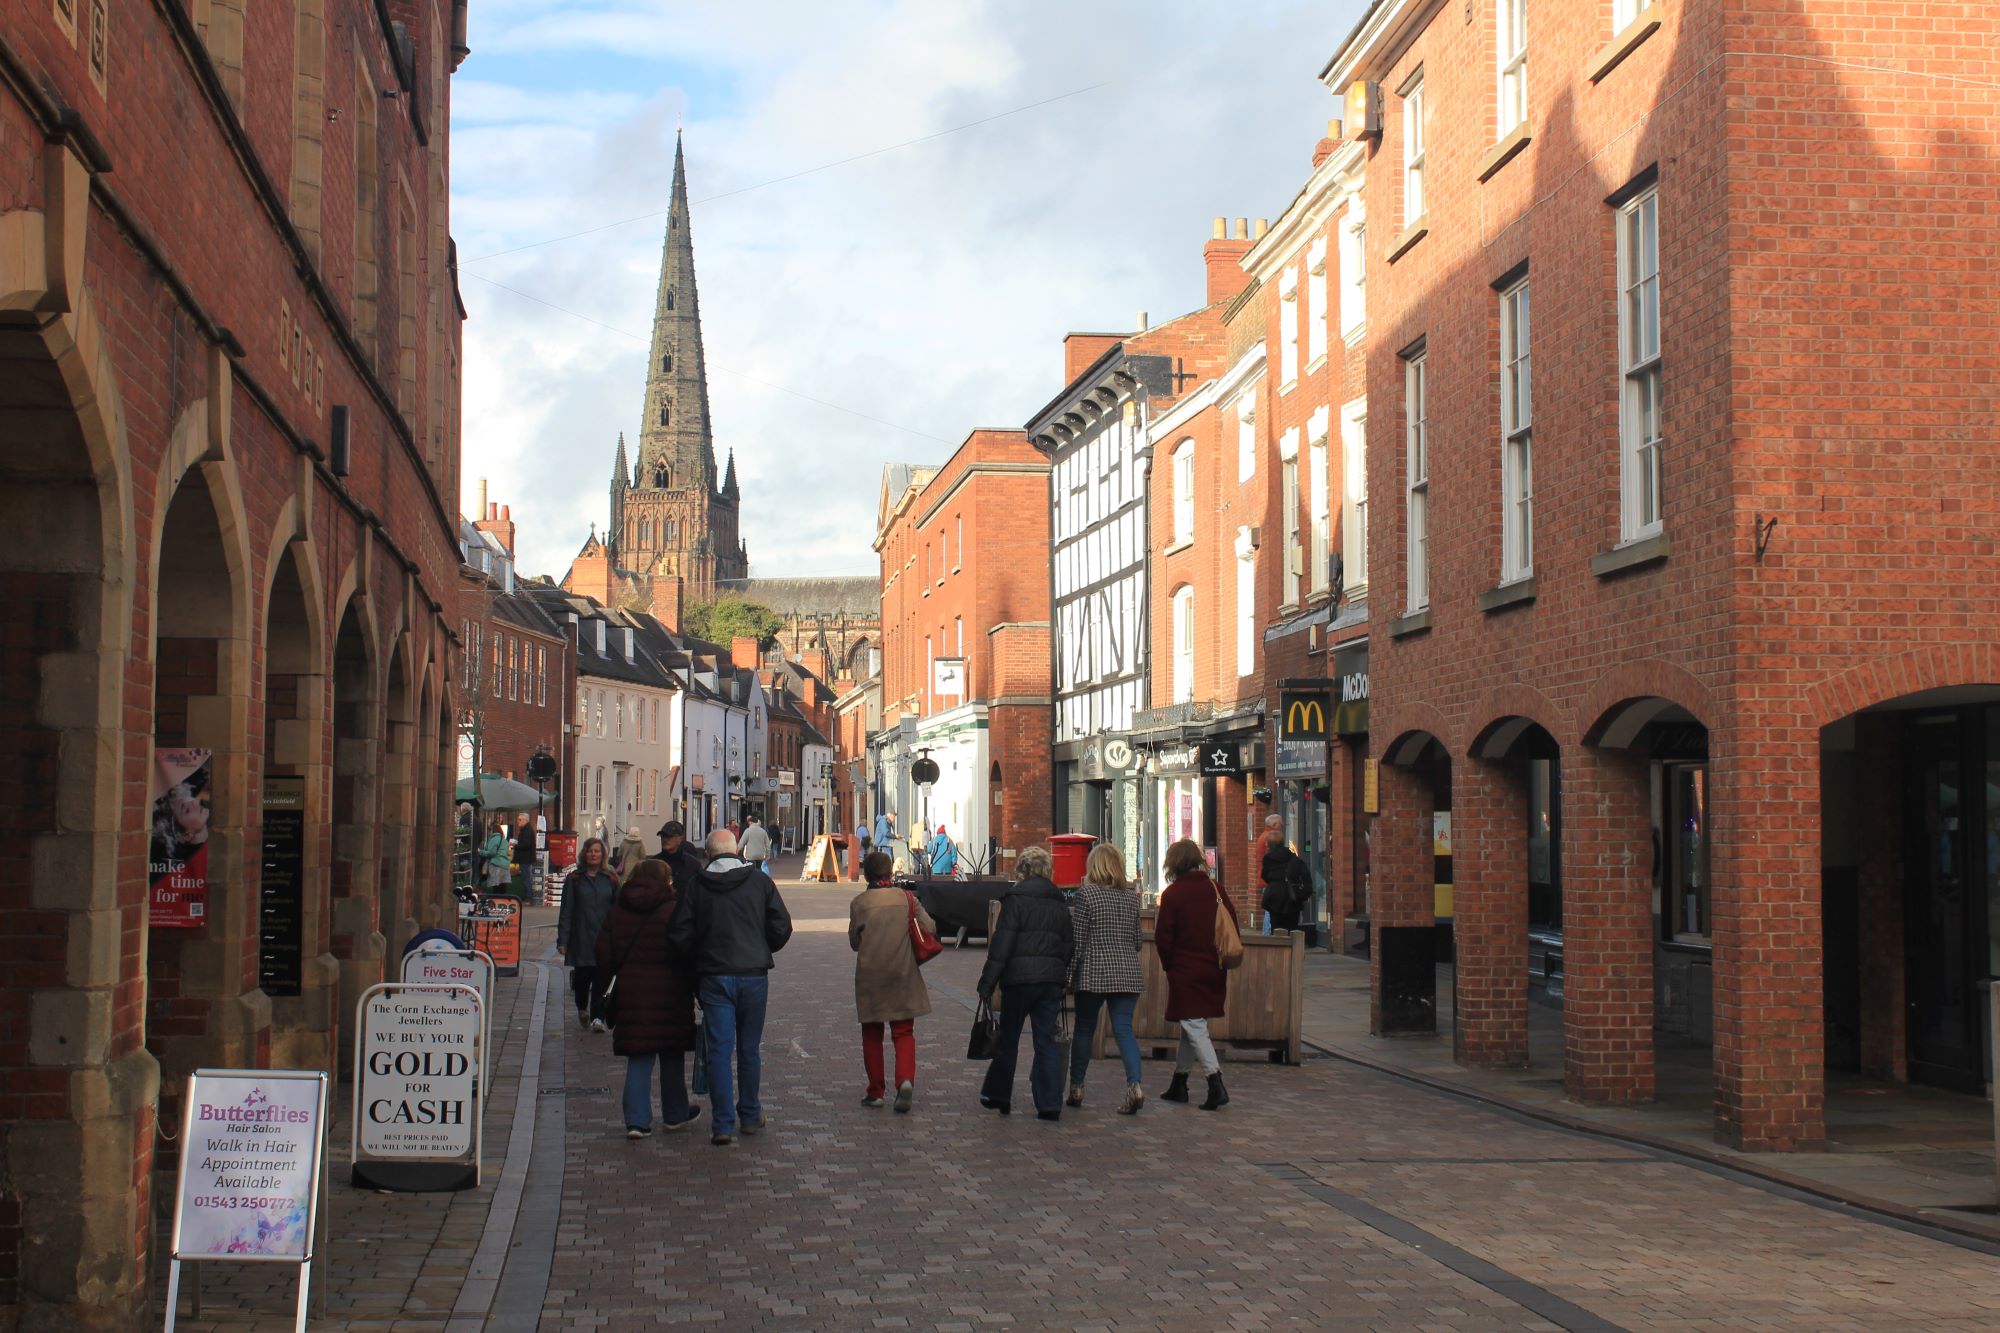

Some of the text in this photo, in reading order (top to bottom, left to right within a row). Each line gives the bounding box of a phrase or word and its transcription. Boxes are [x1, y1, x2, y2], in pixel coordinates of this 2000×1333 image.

[1342, 672, 1369, 702] McDO
[1159, 749, 1189, 769] Superdrug
[170, 875, 205, 889] time
[156, 888, 180, 903] for
[423, 966, 474, 980] Five Star
[373, 1004, 470, 1016] The Corn Exchange
[398, 1016, 443, 1026] Jewellers
[376, 1032, 464, 1044] WE BUY YOUR
[369, 1051, 469, 1077] GOLD
[405, 1083, 431, 1093] FOR
[199, 1104, 310, 1123] Butterflies
[368, 1099, 465, 1125] CASH
[226, 1123, 282, 1134] Hair Salon
[207, 1138, 297, 1153] Walk in Hair
[367, 1143, 380, 1151] WE
[381, 1143, 401, 1151] WILL
[200, 1157, 297, 1173] Appointment
[214, 1175, 282, 1189] Available
[194, 1196, 296, 1210] 01543 250772
